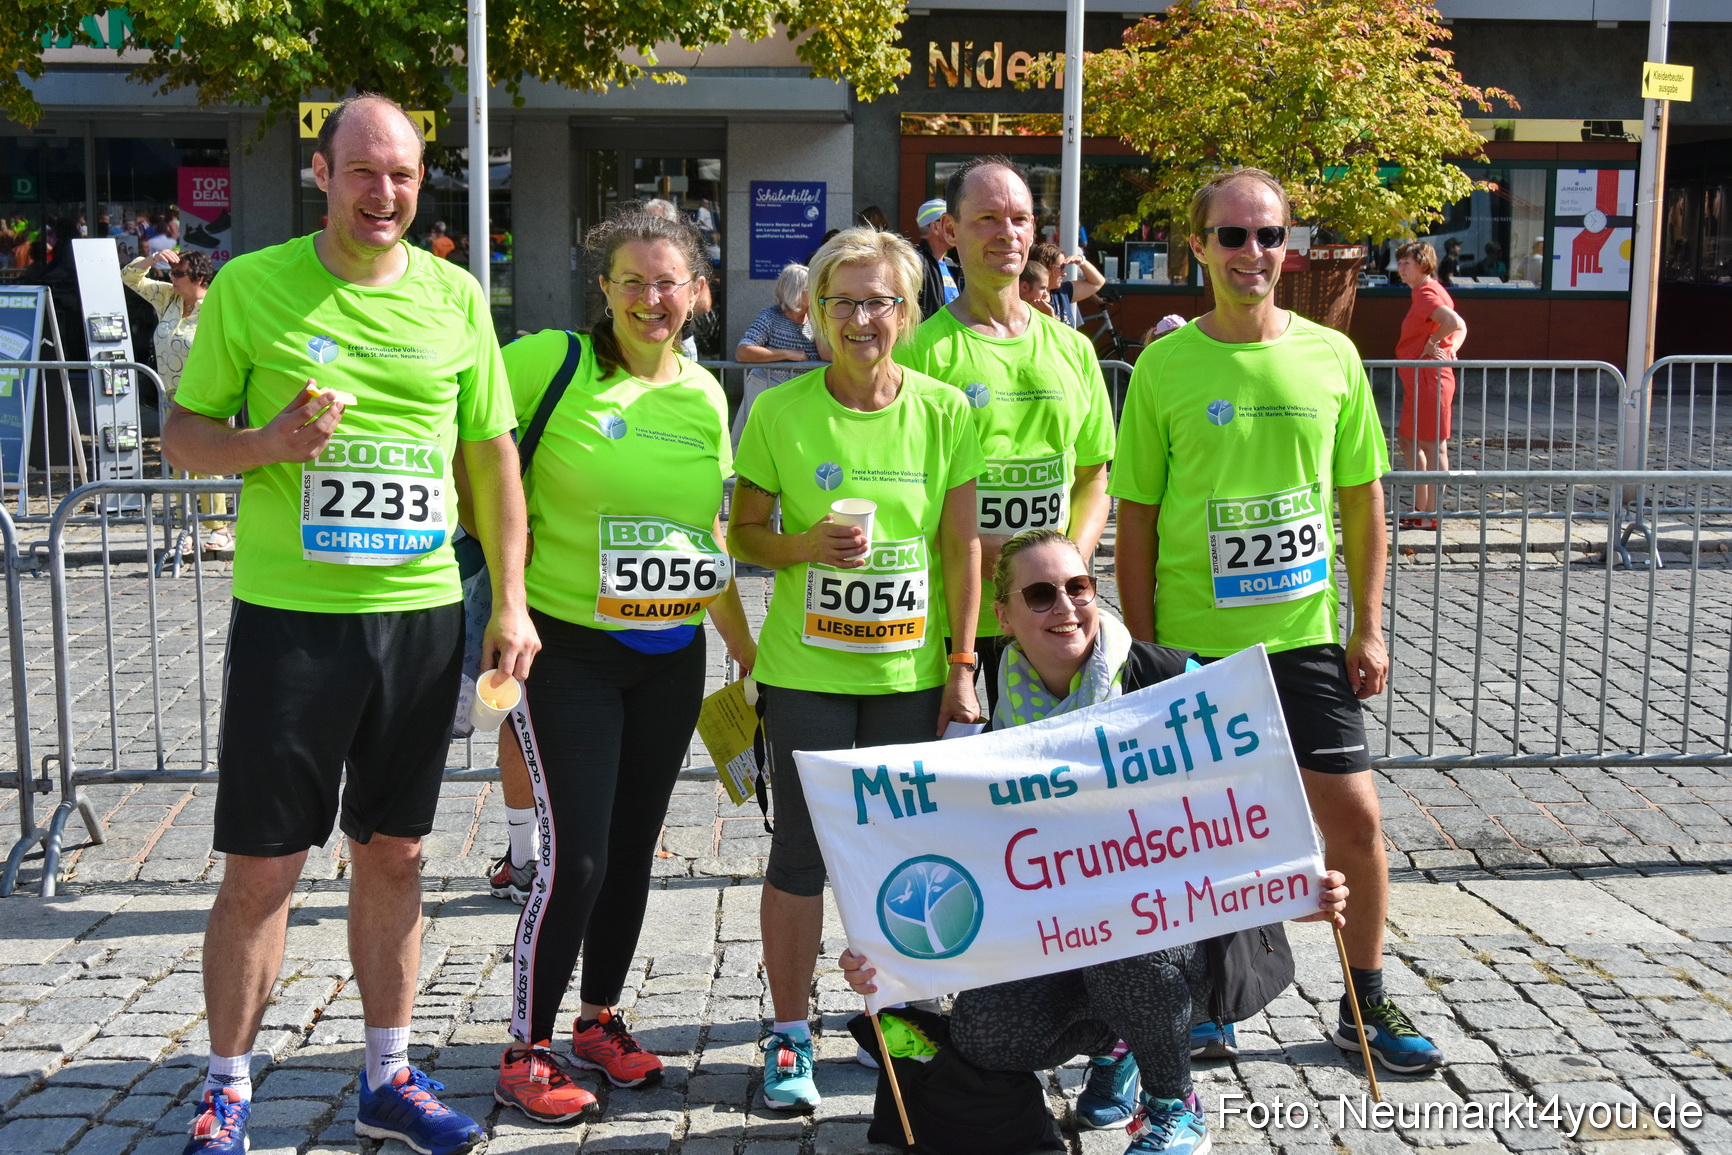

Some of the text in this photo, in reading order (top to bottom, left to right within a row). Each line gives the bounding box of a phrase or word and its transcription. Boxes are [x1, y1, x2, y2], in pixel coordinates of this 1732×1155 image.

[1659, 85, 1678, 95] ausgabe
[193, 177, 228, 190] TOP
[193, 191, 229, 200] DEAL
[365, 345, 401, 353] katholische
[315, 439, 435, 473] BOCK
[976, 458, 1062, 487] BOCK
[320, 479, 430, 522] 2233
[980, 492, 1060, 529] 5059
[1216, 488, 1316, 527] BOCK
[315, 531, 434, 550] CHRISTIAN
[1225, 524, 1316, 569] 2239
[615, 557, 717, 592] 5056
[720, 558, 725, 567] S
[1239, 568, 1312, 593] ROLAND
[620, 602, 701, 617] CLAUDIA
[819, 577, 916, 615] 5054
[919, 579, 924, 587] S
[817, 618, 915, 638] LIESELOTTE
[522, 731, 541, 783] adidas
[852, 690, 1260, 825] Mit uns läufts
[541, 816, 551, 867] adidas
[1004, 787, 1270, 891] Grundschule
[522, 895, 543, 945] adidas
[1037, 916, 1112, 956] Haus
[1186, 869, 1309, 923] Marien
[517, 973, 528, 1020] adidas
